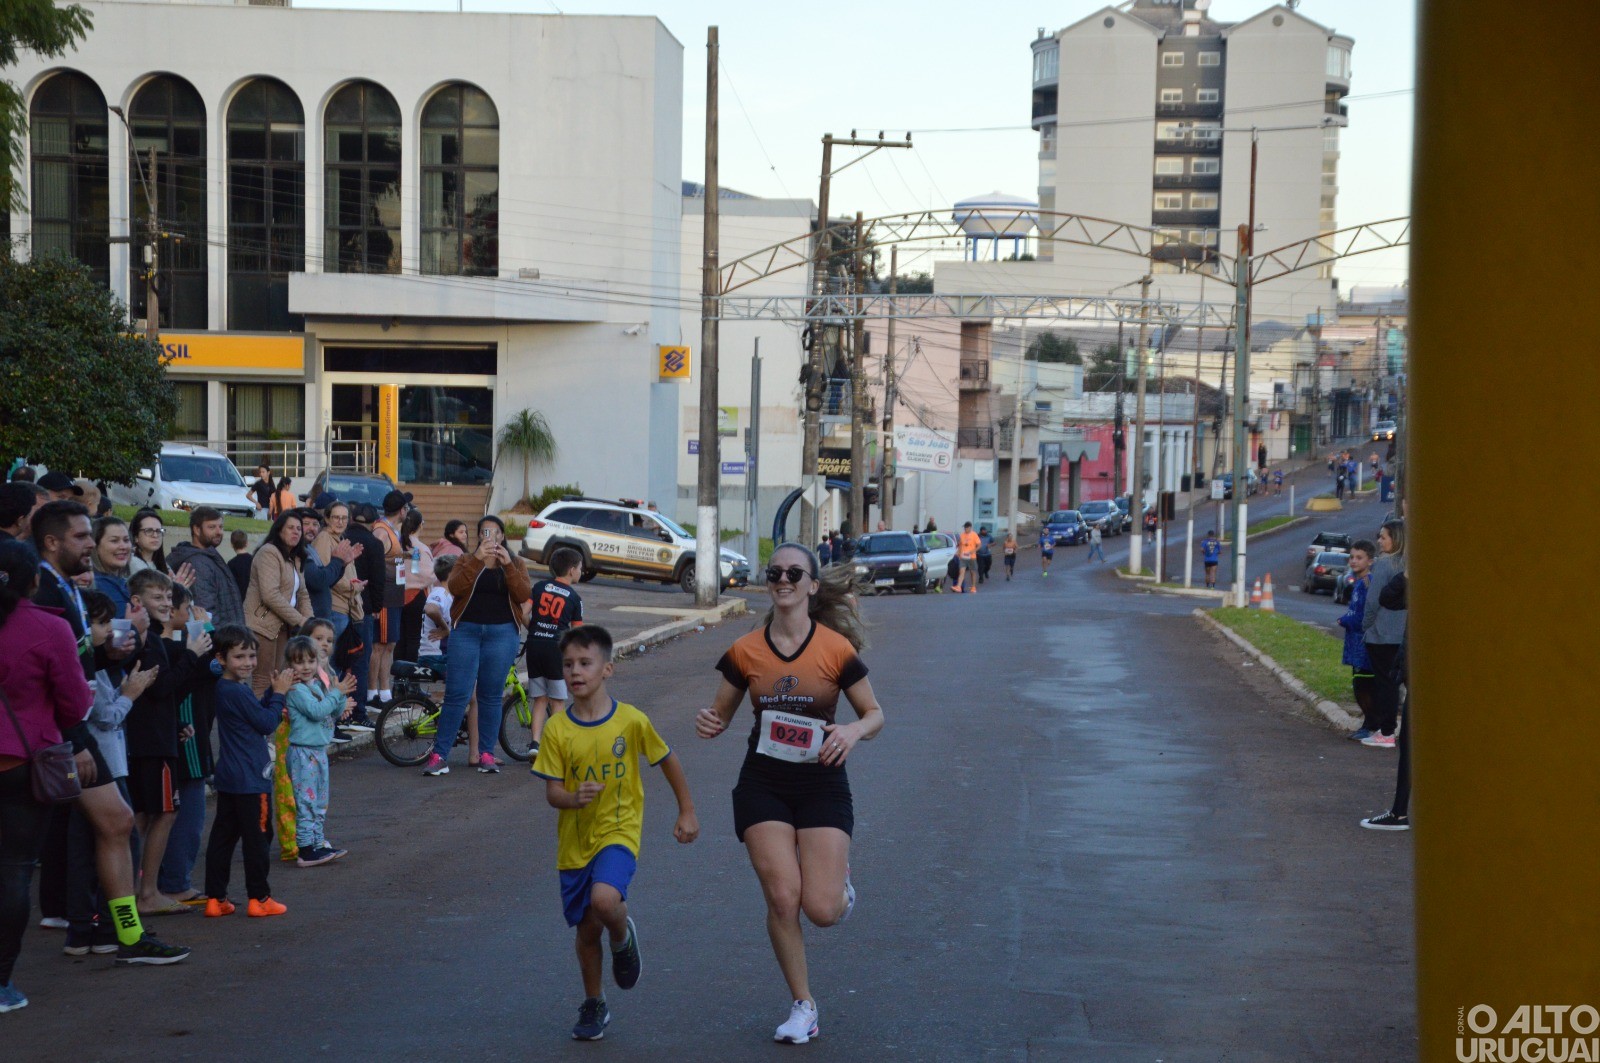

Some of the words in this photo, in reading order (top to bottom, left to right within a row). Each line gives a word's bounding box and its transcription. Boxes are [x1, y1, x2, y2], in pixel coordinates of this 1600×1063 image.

[158, 343, 192, 358] ASIL
[384, 392, 392, 459] Autoatendimento
[938, 454, 946, 465] E
[592, 541, 621, 554] 12251
[626, 549, 655, 557] MILITAR
[627, 544, 655, 553] BRIGADA
[538, 591, 566, 619] 50
[413, 666, 432, 677] XR
[760, 694, 779, 704] Med
[781, 694, 814, 703] Forma
[776, 726, 809, 745] 024
[571, 761, 626, 781] KAFD
[114, 904, 138, 929] RUN
